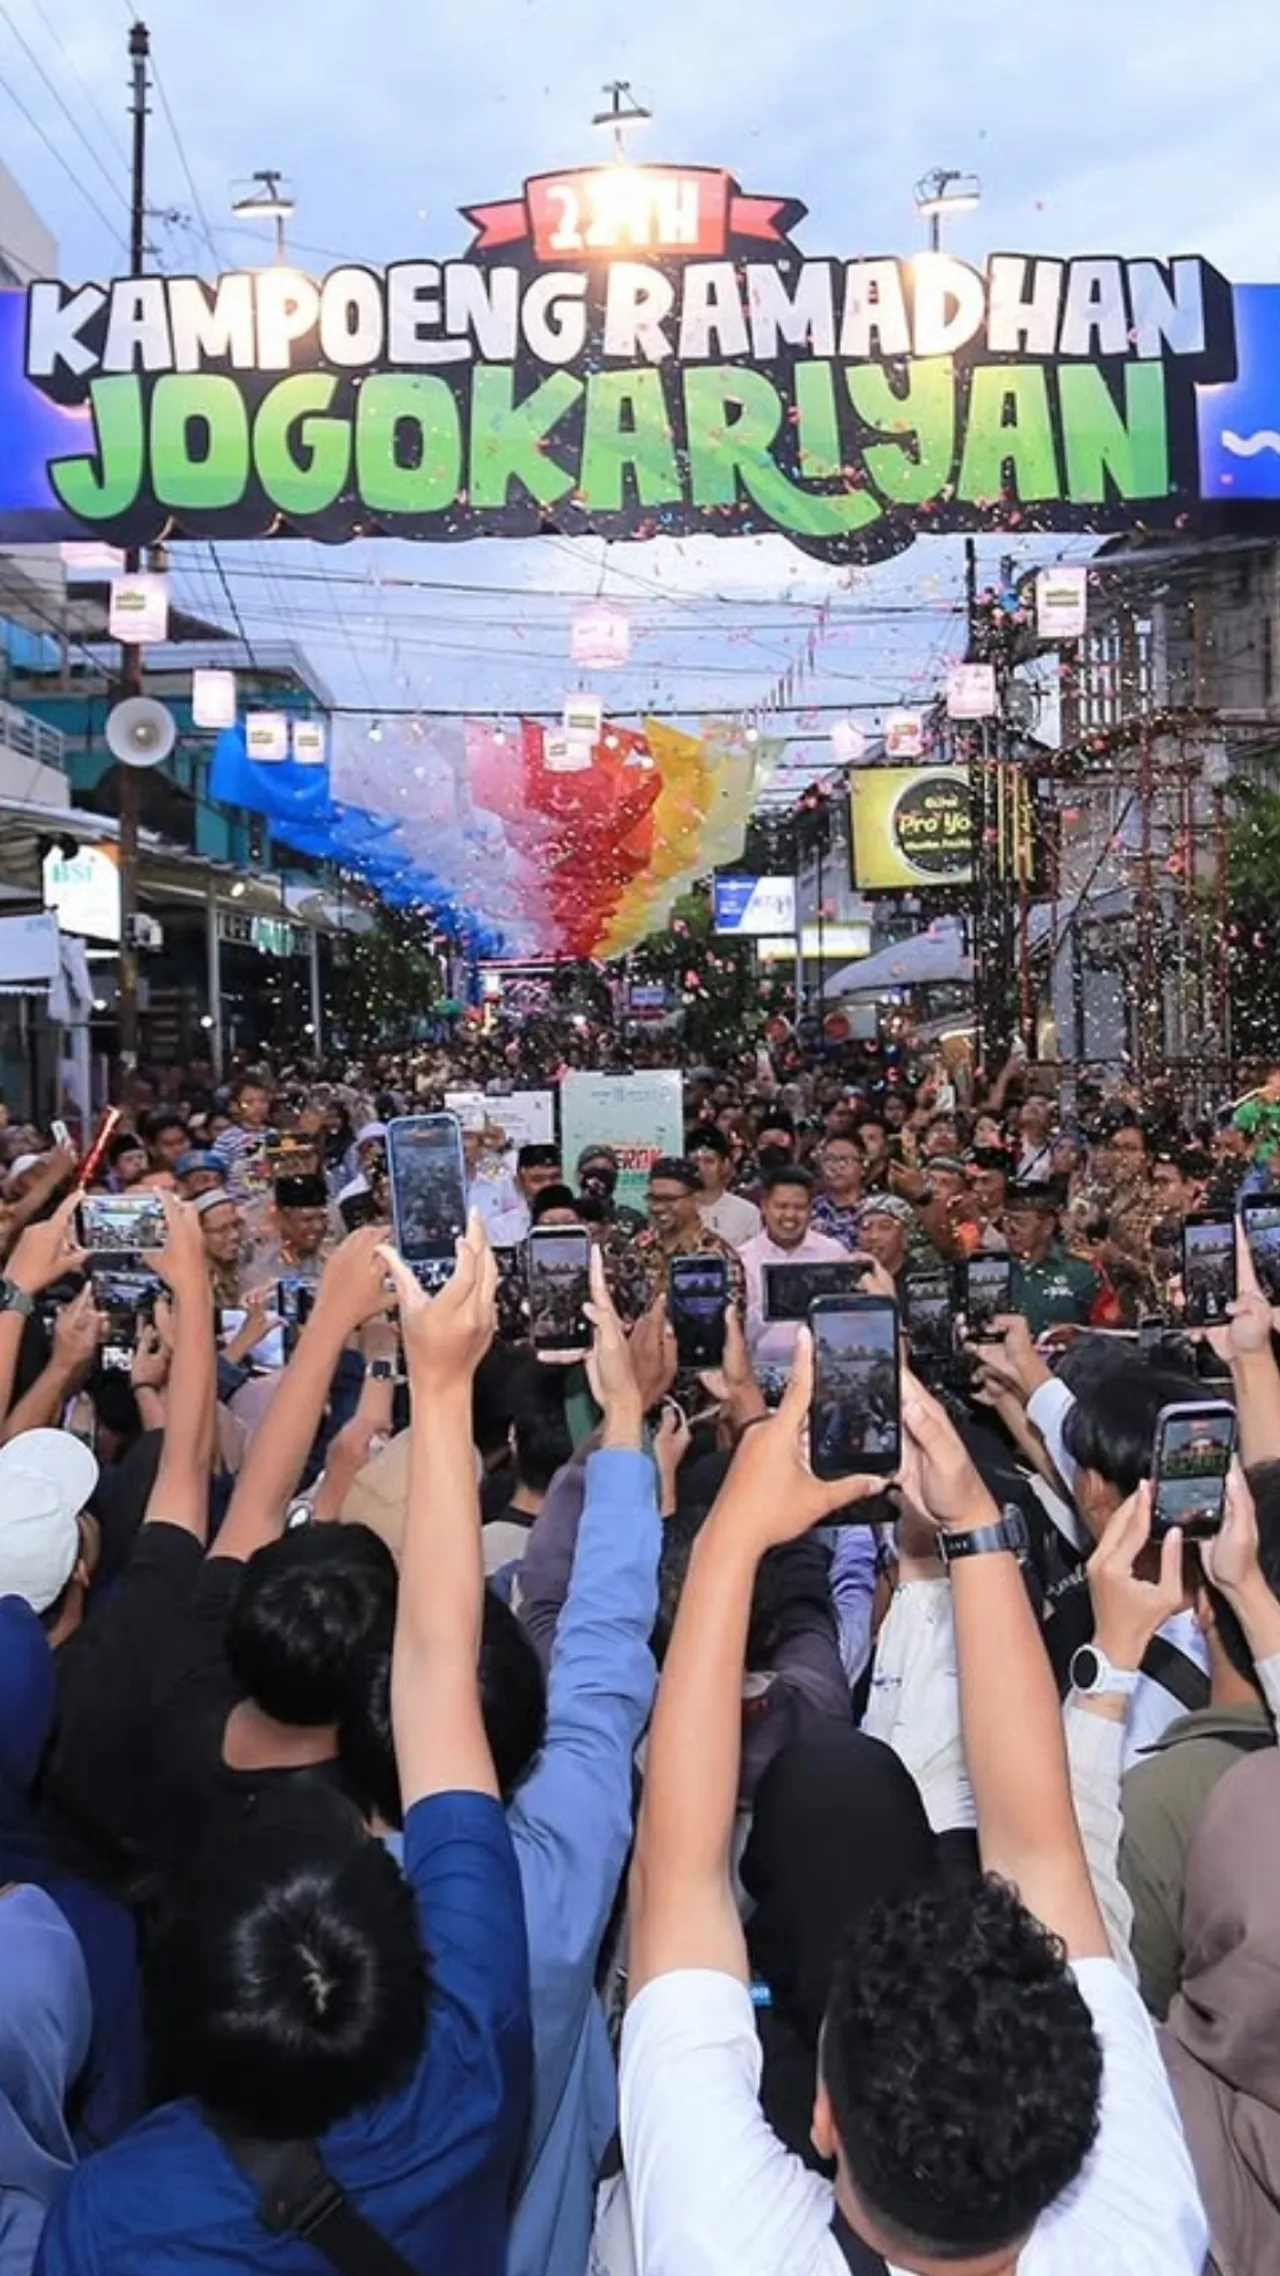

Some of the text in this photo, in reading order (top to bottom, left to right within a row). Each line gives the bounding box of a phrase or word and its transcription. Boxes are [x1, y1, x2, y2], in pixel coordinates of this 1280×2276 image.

[27, 255, 1205, 376] KAMPOENG RAMADHAN
[50, 356, 1169, 537] JOGOKARIYAN
[899, 814, 938, 834] Pro
